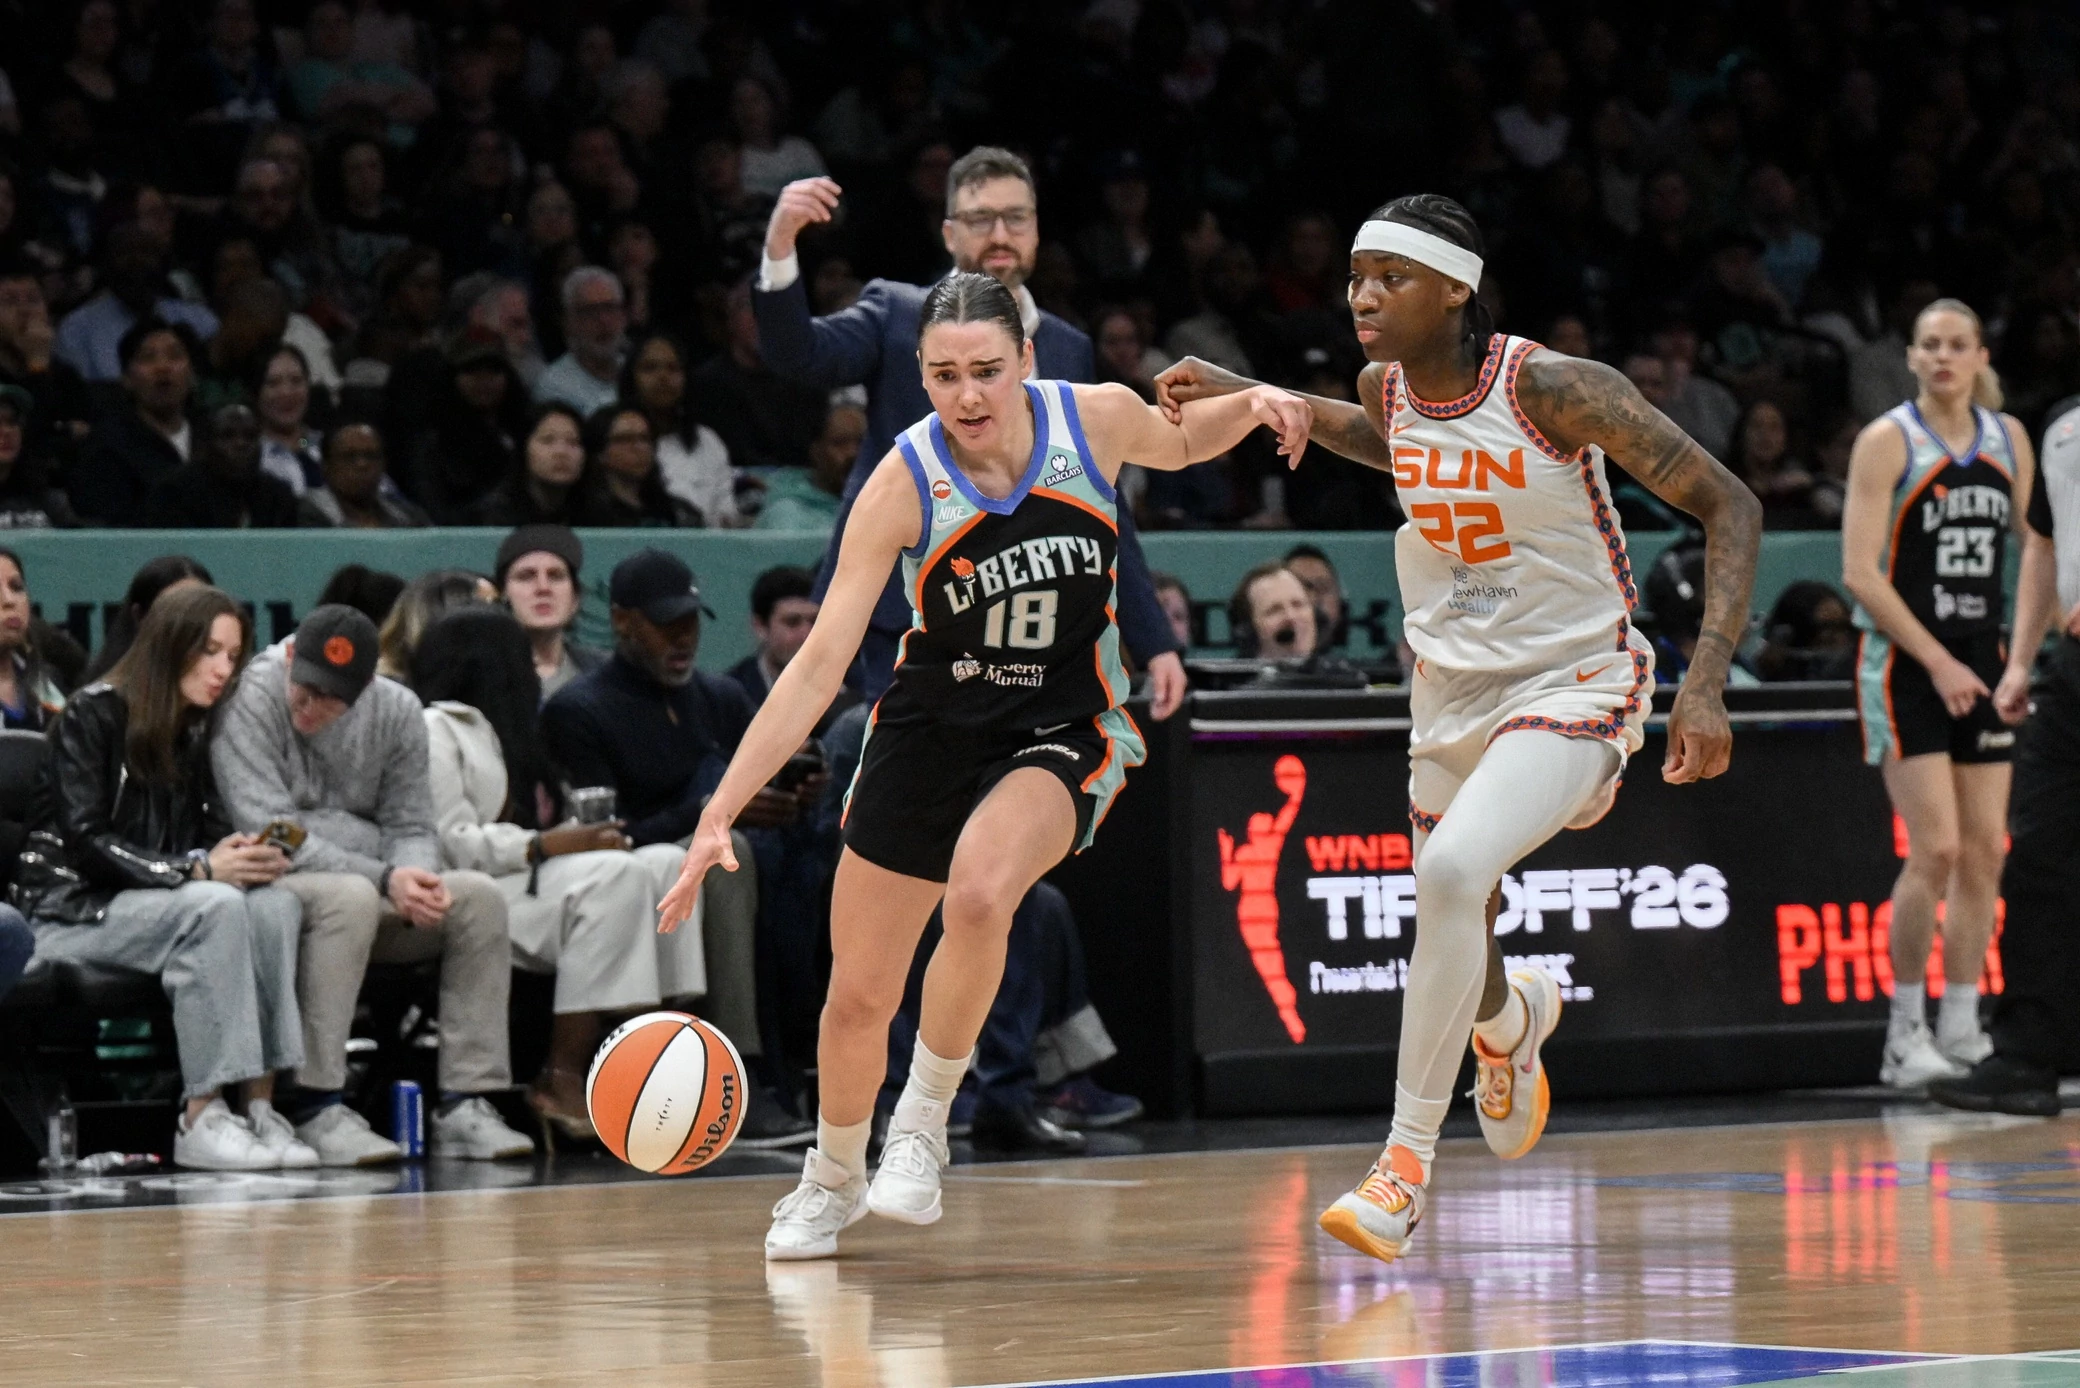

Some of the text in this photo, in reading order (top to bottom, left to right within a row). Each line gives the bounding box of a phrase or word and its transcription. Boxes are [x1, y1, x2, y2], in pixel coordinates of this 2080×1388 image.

[1046, 467, 1081, 486] BARCLAYS
[1393, 447, 1527, 490] SUN
[938, 506, 965, 521] NIKE
[1411, 502, 1512, 564] 22
[1936, 526, 1996, 578] 23
[943, 536, 1102, 616] LIBERTY
[1450, 565, 1468, 584] Yae
[984, 589, 1059, 649] 18
[984, 668, 1043, 687] Mutual
[1305, 833, 1413, 871] WNB
[680, 1072, 735, 1167] Wilson
